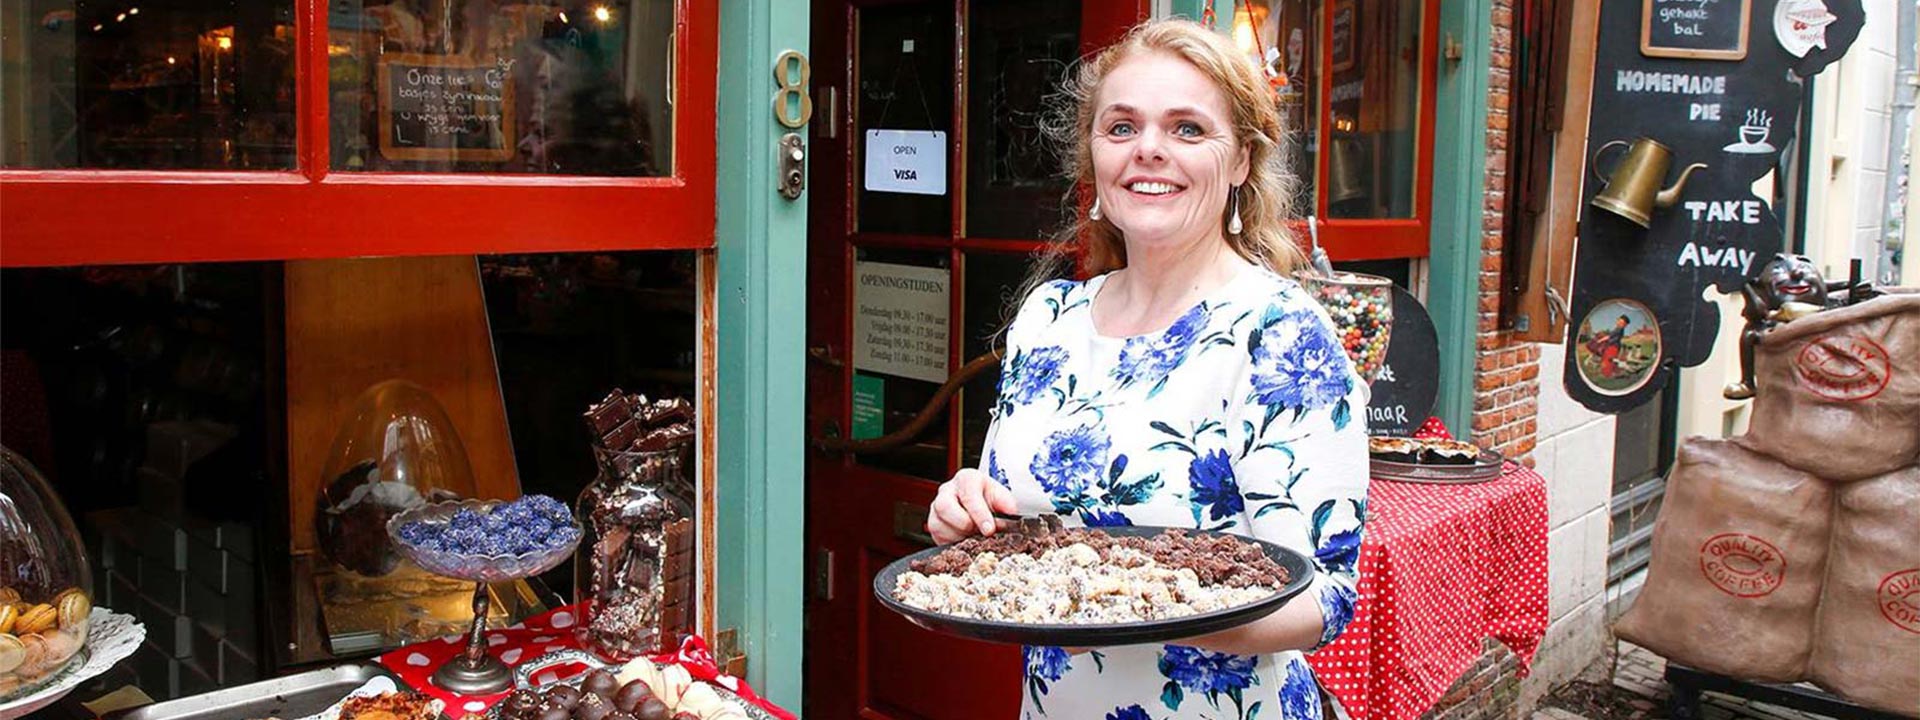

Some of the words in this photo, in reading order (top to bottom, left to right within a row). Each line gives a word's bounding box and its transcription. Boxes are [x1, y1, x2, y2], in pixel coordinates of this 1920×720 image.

[1660, 8, 1708, 23] gehakt
[407, 68, 444, 86] Onze
[1616, 70, 1726, 94] HOMEMADE
[775, 49, 813, 128] 8
[1689, 103, 1721, 121] PIE
[893, 145, 917, 156] OPEN
[893, 169, 917, 181] VISA
[1684, 201, 1760, 224] TAKE
[1678, 242, 1756, 276] AWAY
[1710, 540, 1775, 562] QUALITY
[1706, 562, 1774, 589] COFFEE
